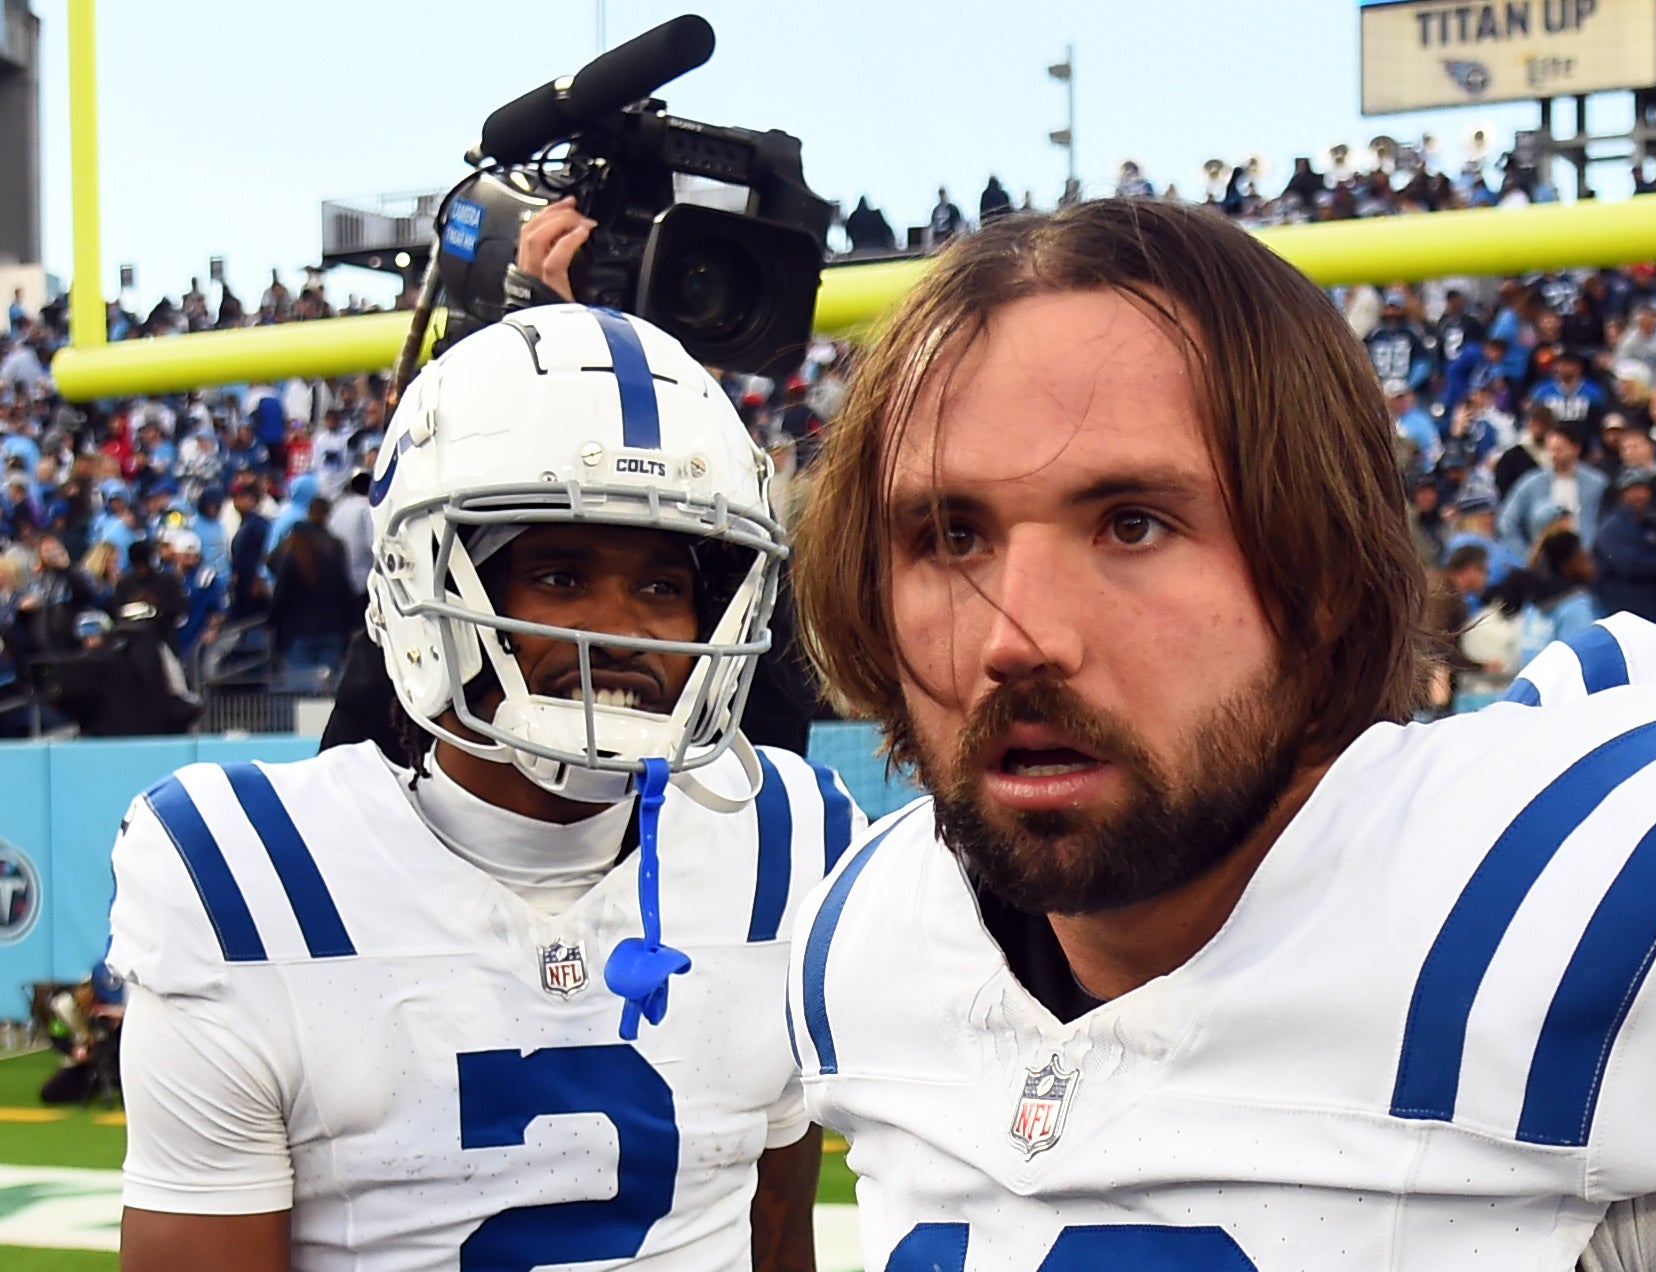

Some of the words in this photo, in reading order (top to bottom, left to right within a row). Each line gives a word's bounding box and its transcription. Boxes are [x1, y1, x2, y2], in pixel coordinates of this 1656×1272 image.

[1416, 4, 1530, 46] TITAN
[1544, 0, 1597, 33] UP
[616, 458, 666, 477] COLTS
[549, 963, 582, 988] NFL
[1016, 1103, 1054, 1140] NFL
